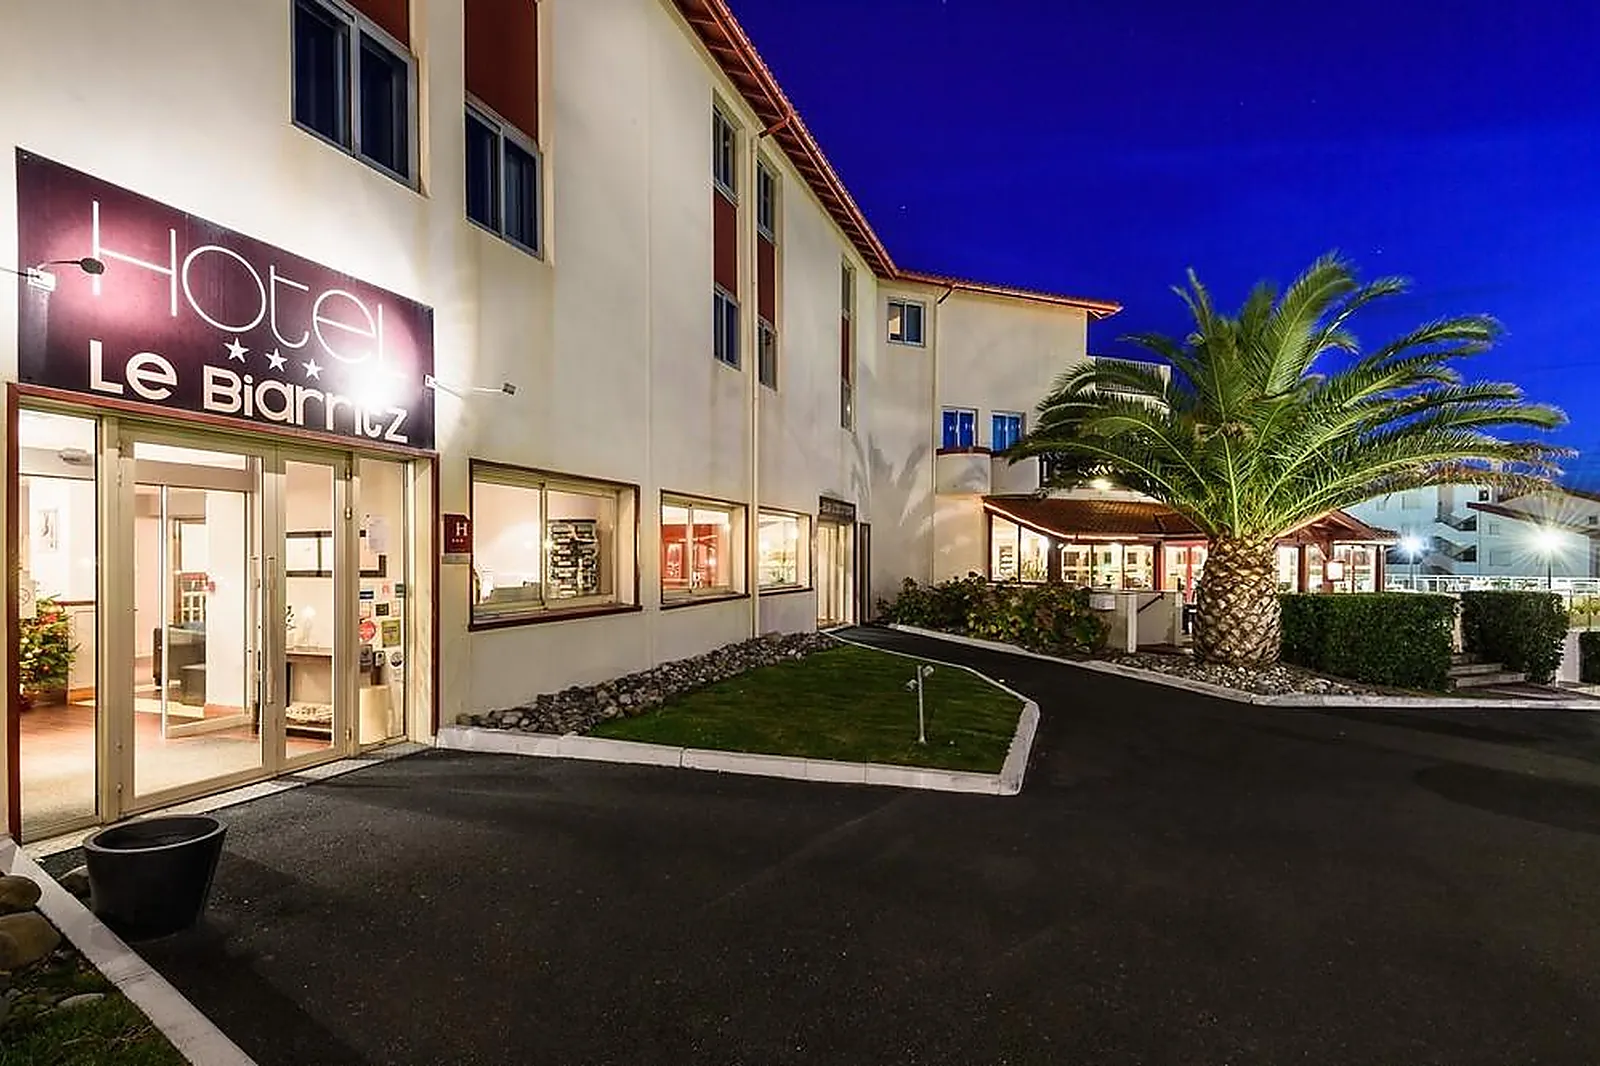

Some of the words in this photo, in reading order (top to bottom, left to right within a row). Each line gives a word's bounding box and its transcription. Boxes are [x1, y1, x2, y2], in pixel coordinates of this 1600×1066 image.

[89, 339, 178, 400] Le
[203, 365, 408, 443] Biarritz
[456, 521, 468, 536] H
